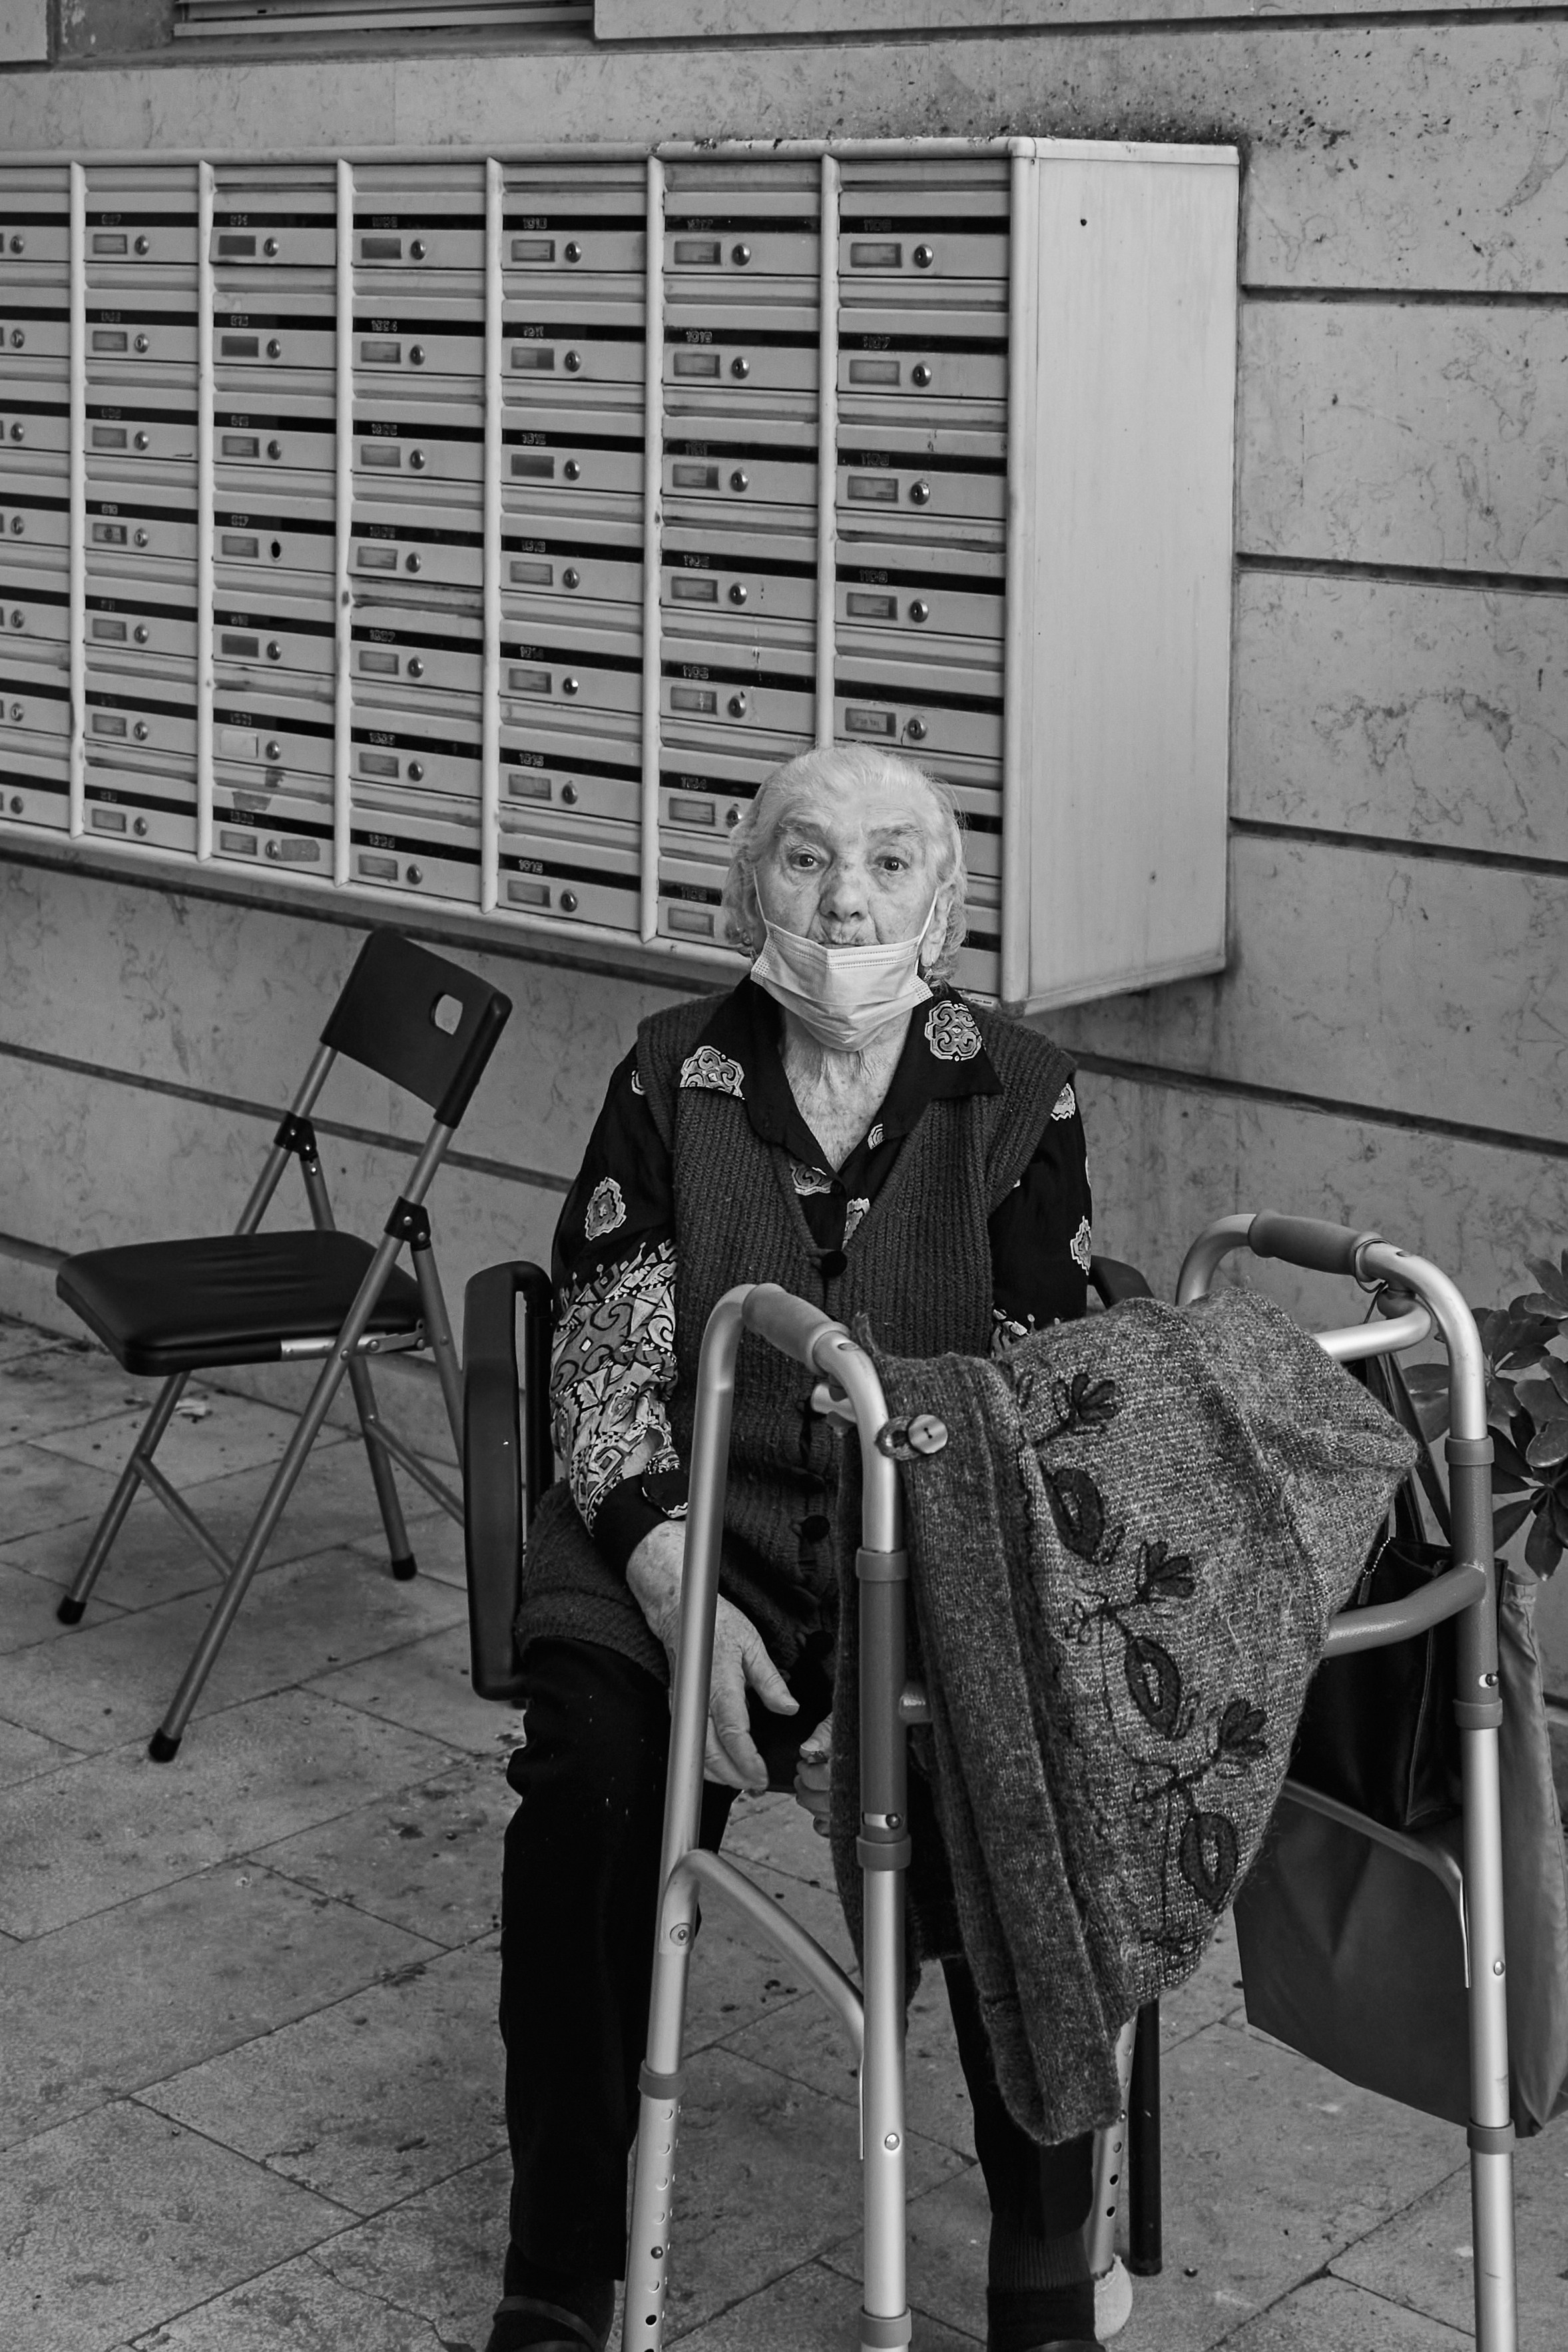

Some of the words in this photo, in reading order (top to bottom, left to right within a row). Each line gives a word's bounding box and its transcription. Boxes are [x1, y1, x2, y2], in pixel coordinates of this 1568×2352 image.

[523, 217, 547, 229] 1010
[863, 336, 891, 349] 1107
[683, 665, 709, 679] 1103
